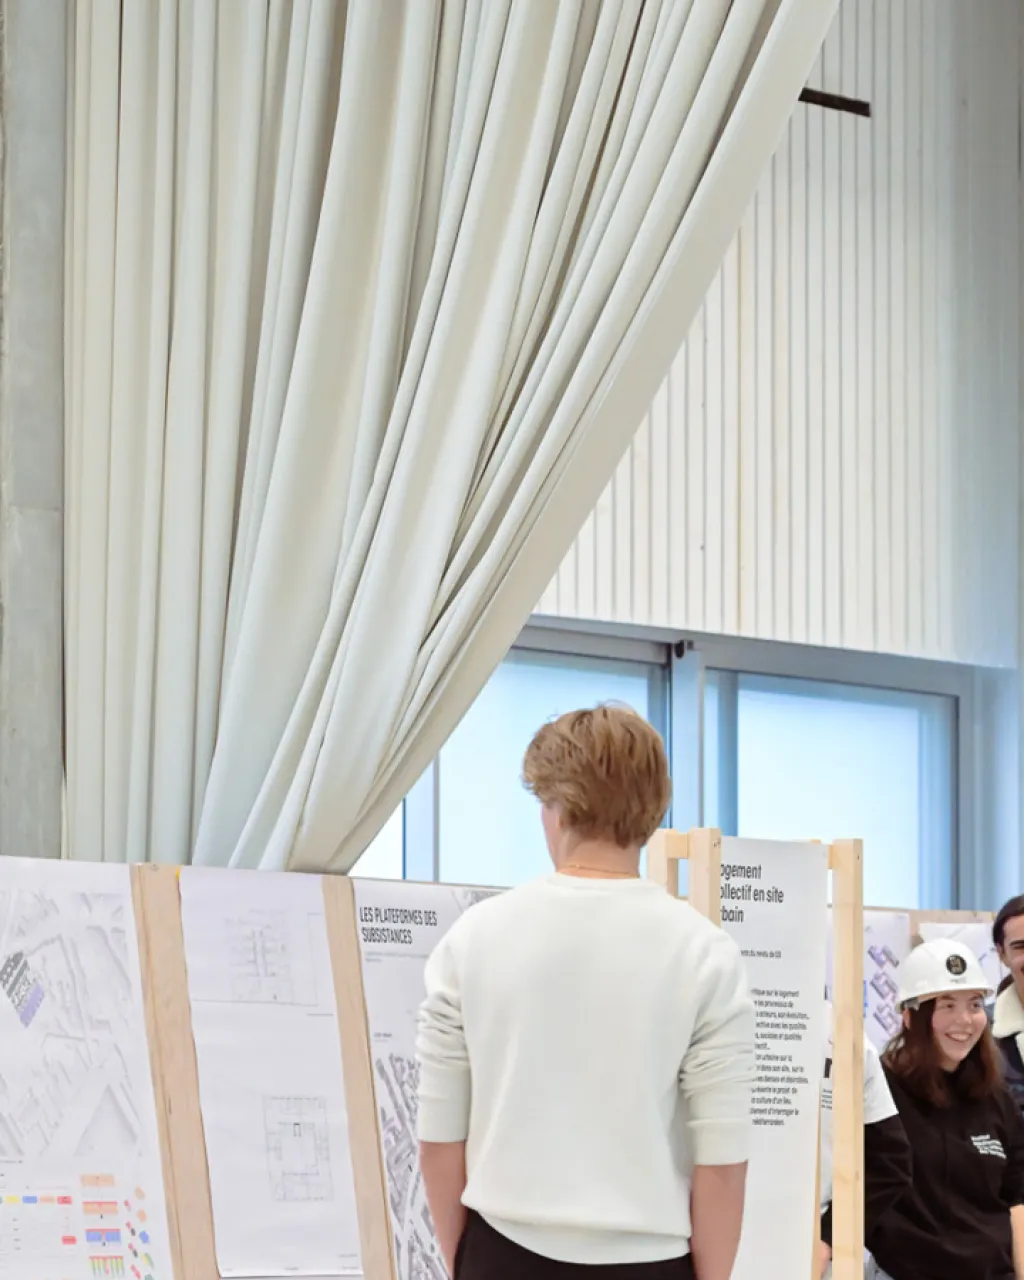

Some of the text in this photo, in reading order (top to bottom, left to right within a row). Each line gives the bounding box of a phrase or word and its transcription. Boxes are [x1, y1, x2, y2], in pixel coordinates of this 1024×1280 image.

[720, 863, 762, 881] ogement
[720, 883, 784, 903] ollectif en site
[359, 906, 438, 926] LES PLATEFORMES DES
[720, 905, 744, 923] bain
[362, 926, 413, 944] SUBSISTANCES
